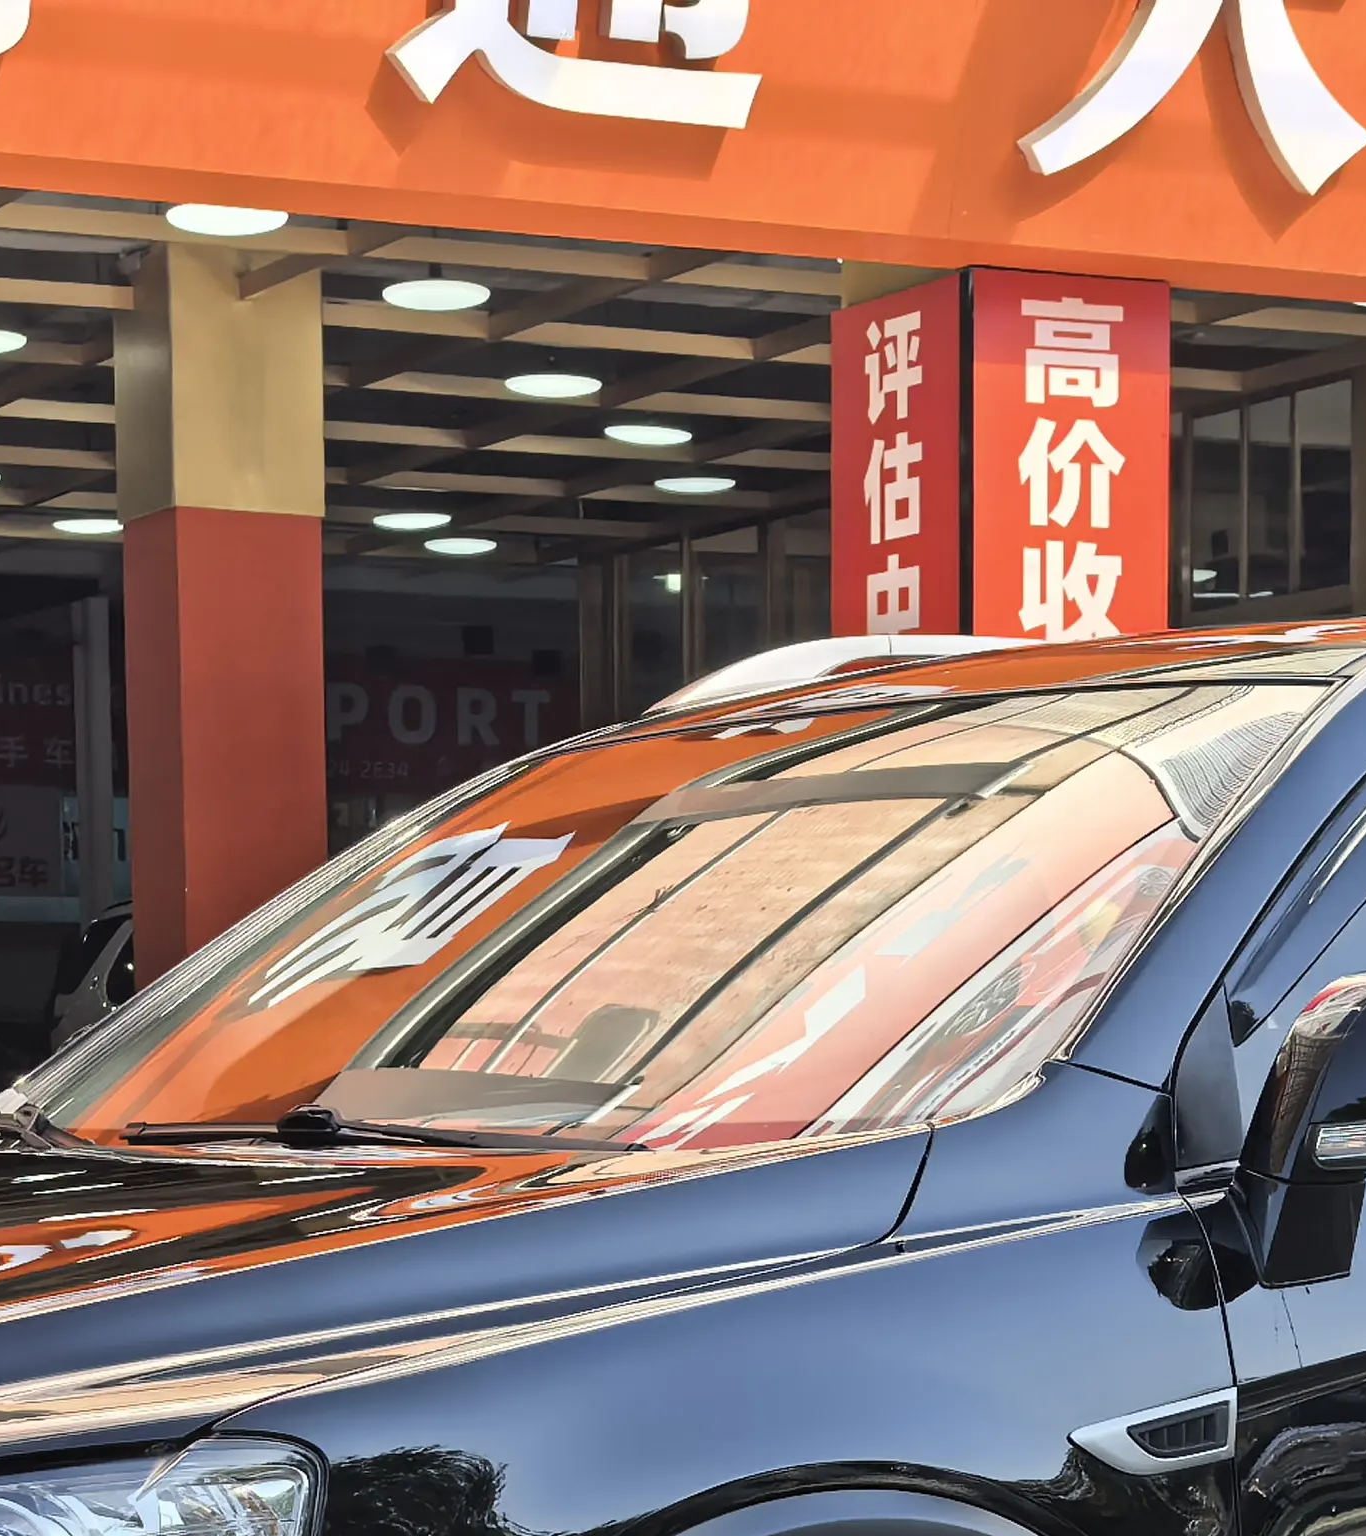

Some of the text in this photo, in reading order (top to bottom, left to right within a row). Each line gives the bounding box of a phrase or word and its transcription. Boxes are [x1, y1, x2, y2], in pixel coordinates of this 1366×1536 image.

[864, 311, 923, 635] 评估中
[1018, 297, 1125, 641] 高价收
